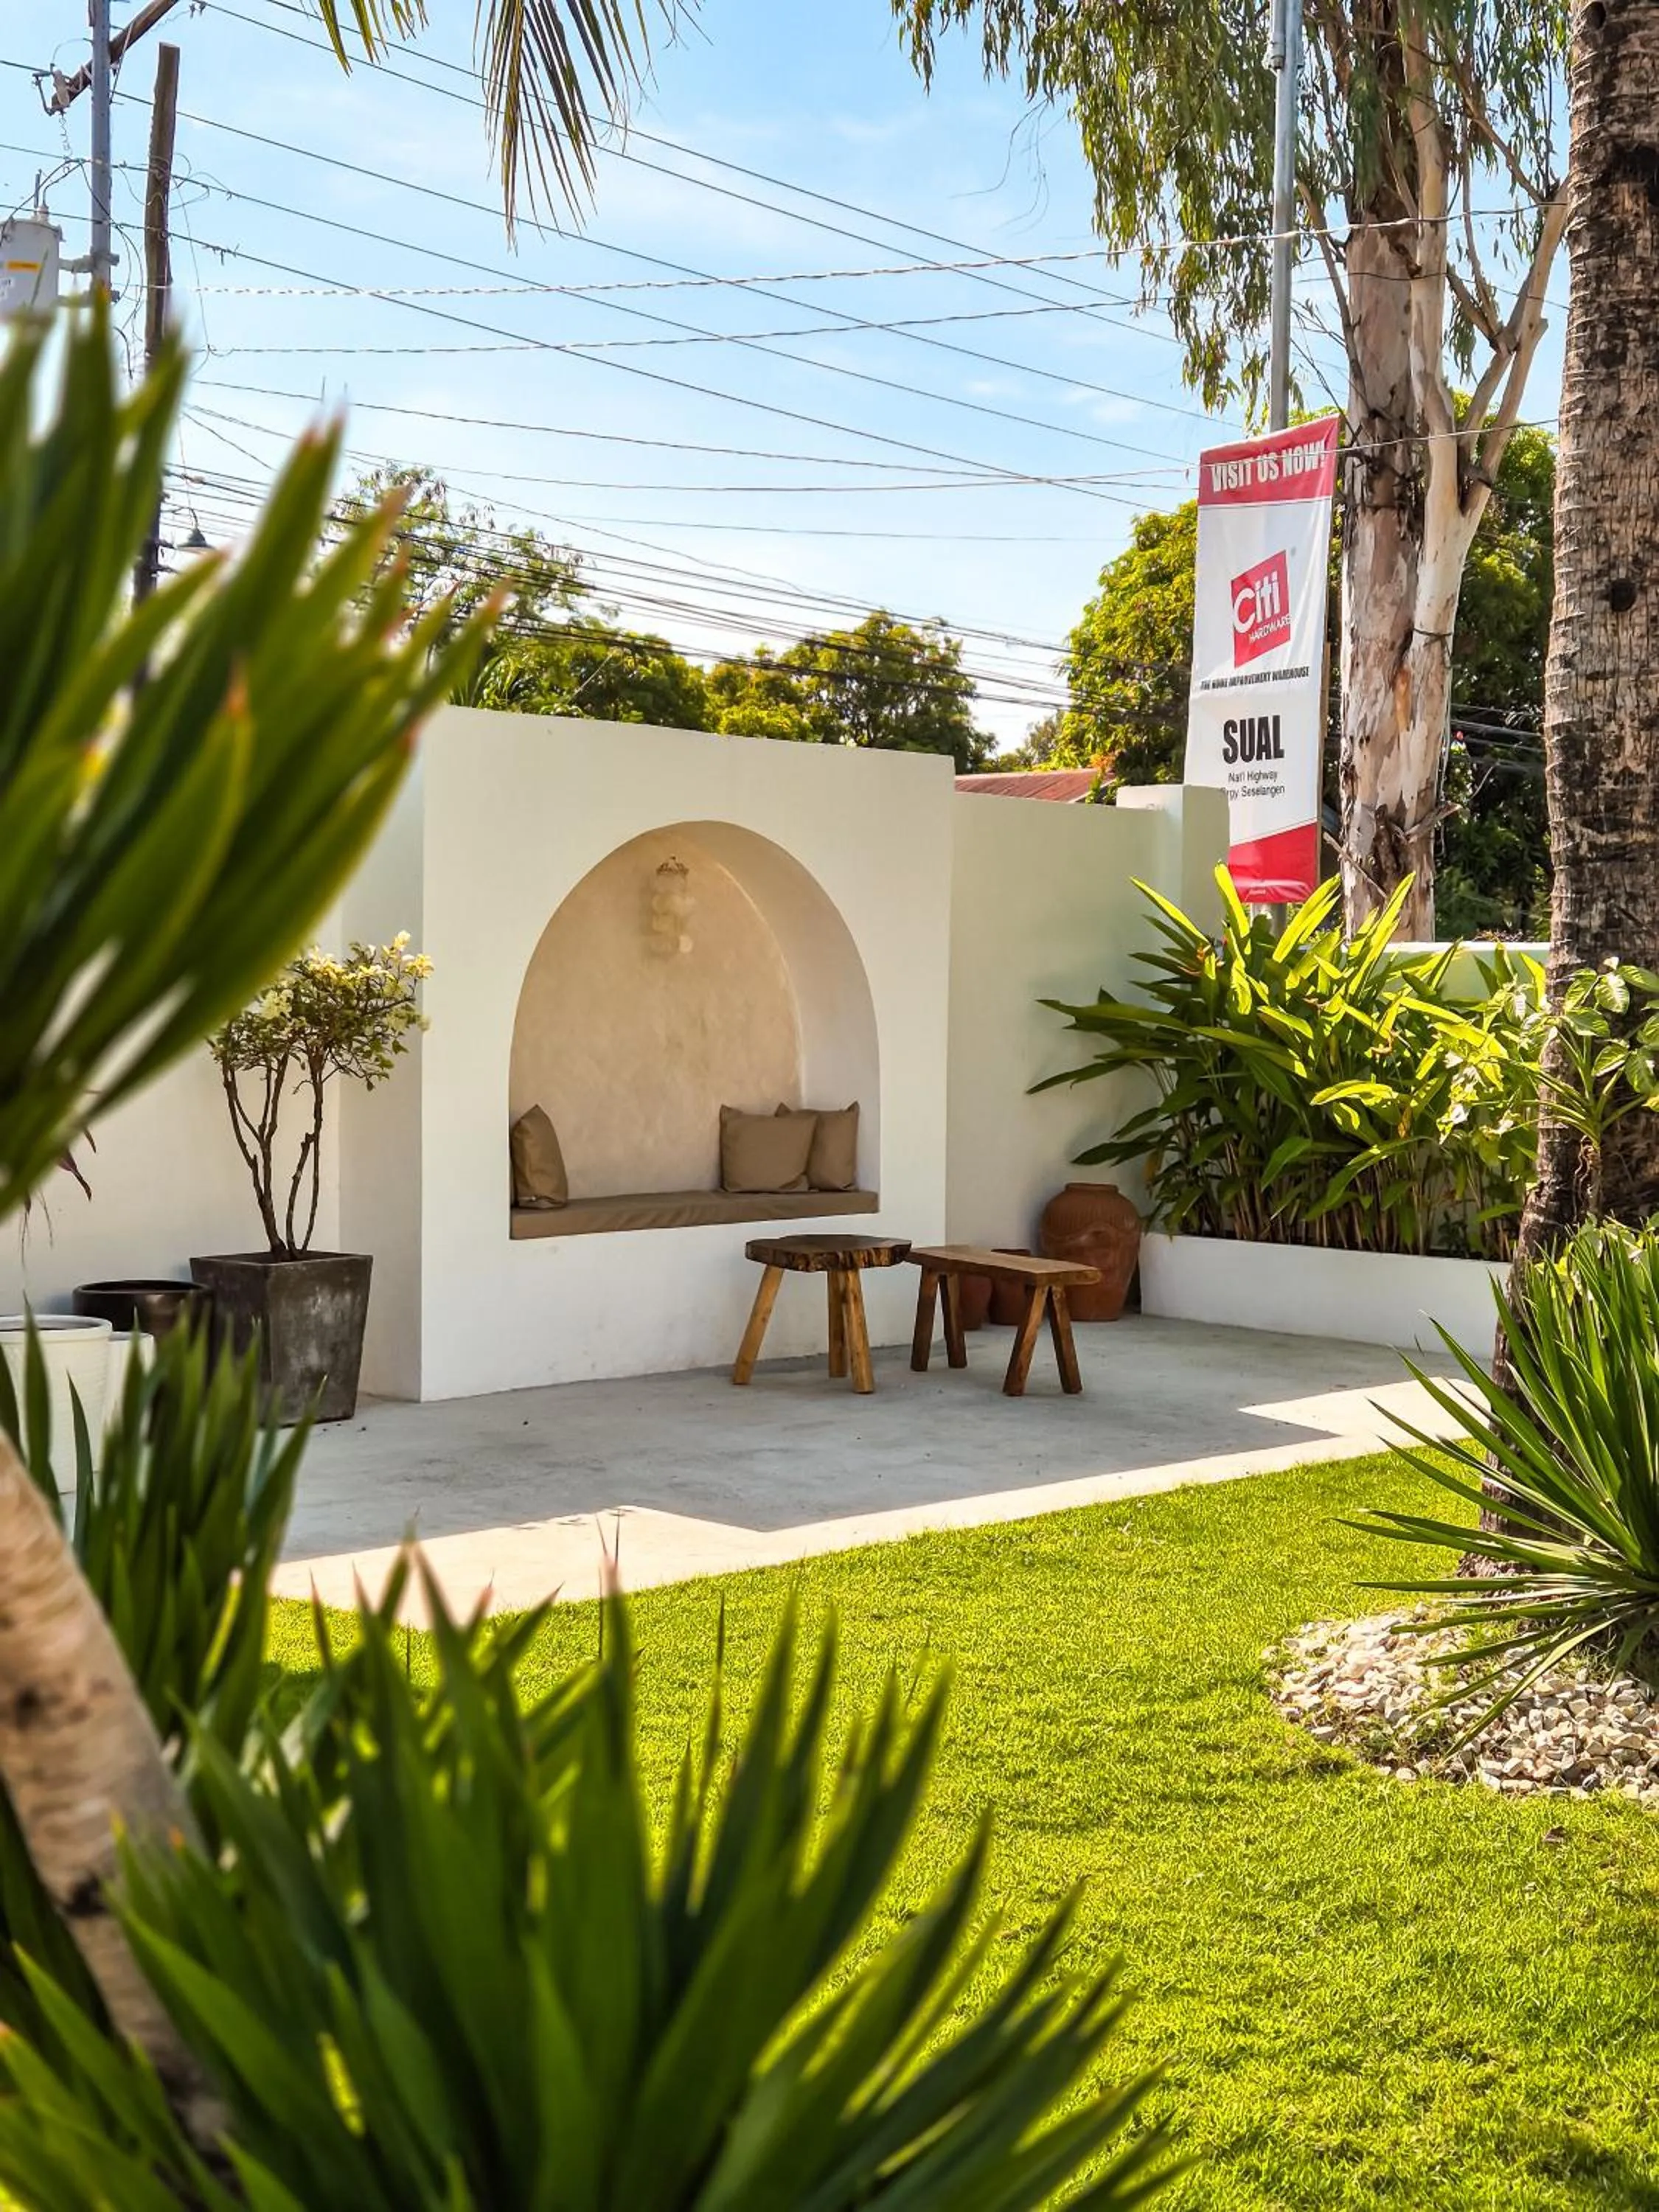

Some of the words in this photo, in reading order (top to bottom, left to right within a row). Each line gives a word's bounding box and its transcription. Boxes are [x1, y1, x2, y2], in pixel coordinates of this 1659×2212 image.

[1211, 457, 1252, 493] VISIT
[1257, 451, 1279, 483] US
[1282, 439, 1326, 478] NOW!
[1234, 571, 1280, 634] Citi
[1249, 613, 1292, 644] HARDWARE
[1211, 677, 1228, 689] HOME
[1228, 672, 1271, 686] IMPROVEMENT
[1273, 666, 1310, 681] WAREHOUSE
[1222, 715, 1284, 764] SUAL
[1247, 770, 1278, 784] Highway
